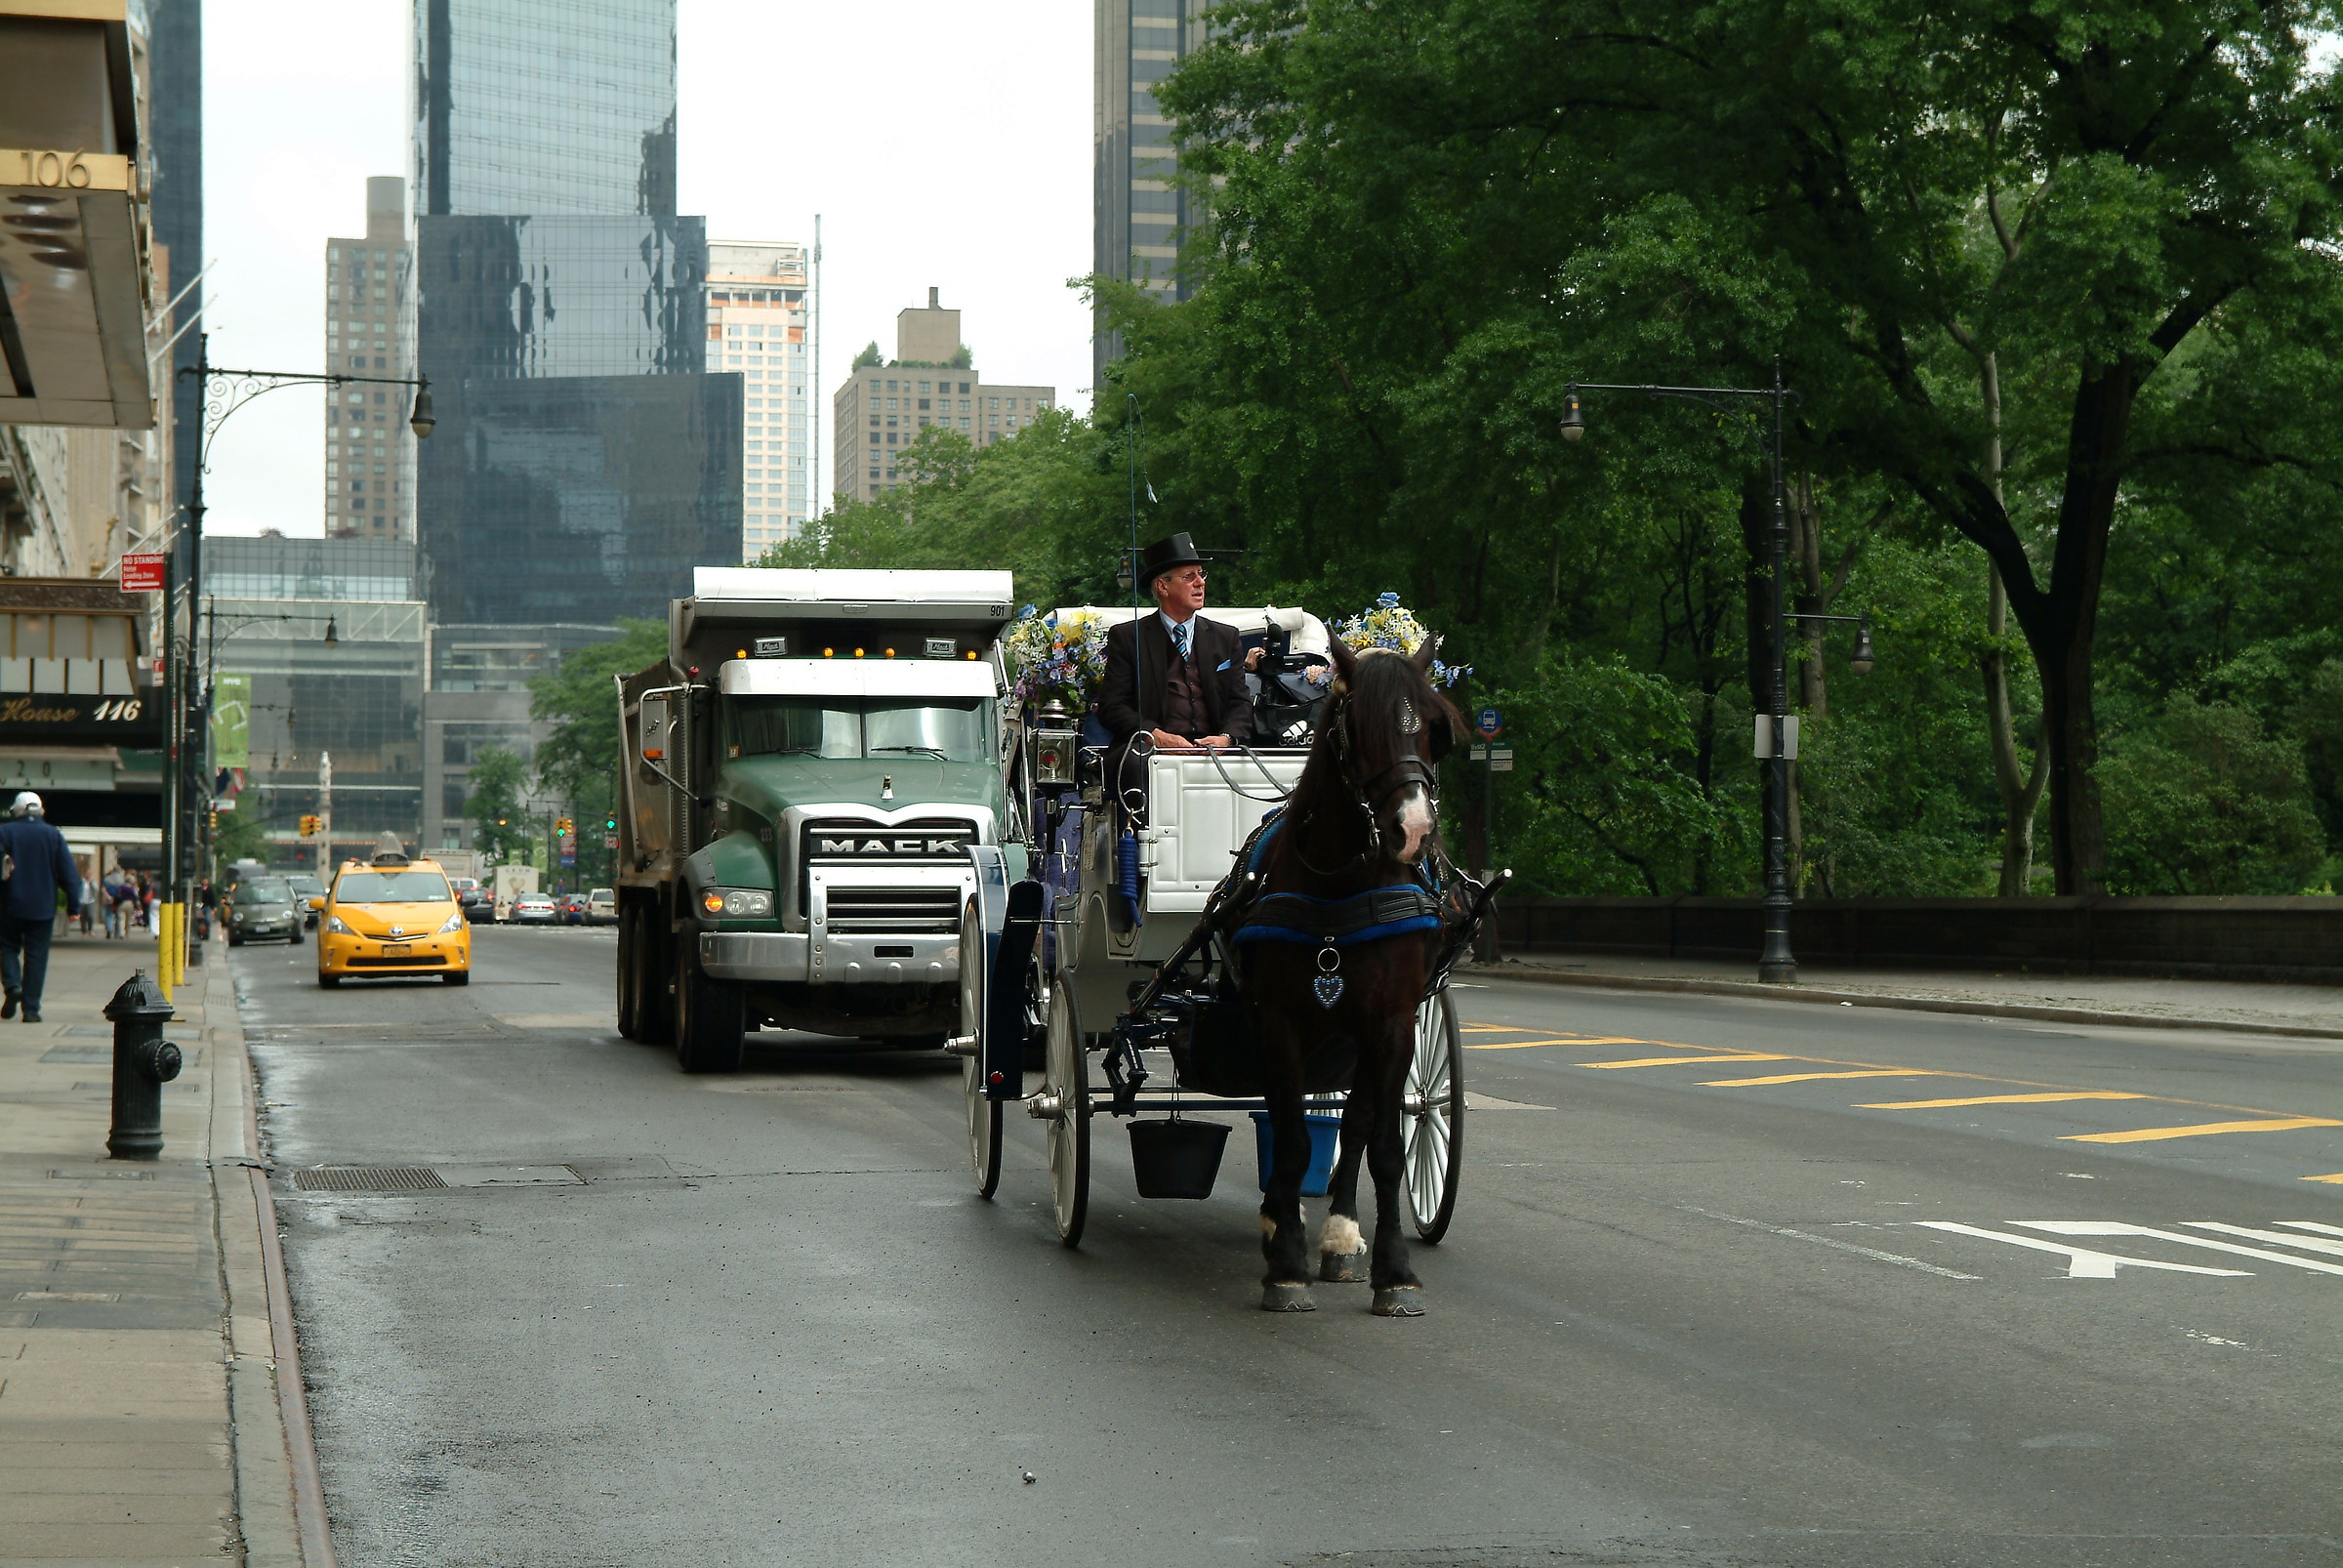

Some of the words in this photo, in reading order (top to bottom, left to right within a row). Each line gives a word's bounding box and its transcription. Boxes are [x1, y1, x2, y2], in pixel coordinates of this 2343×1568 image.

[21, 148, 91, 188] 106
[990, 605, 1005, 616] 901
[0, 697, 80, 722] House
[94, 699, 142, 722] 116
[821, 839, 961, 852] MACK
